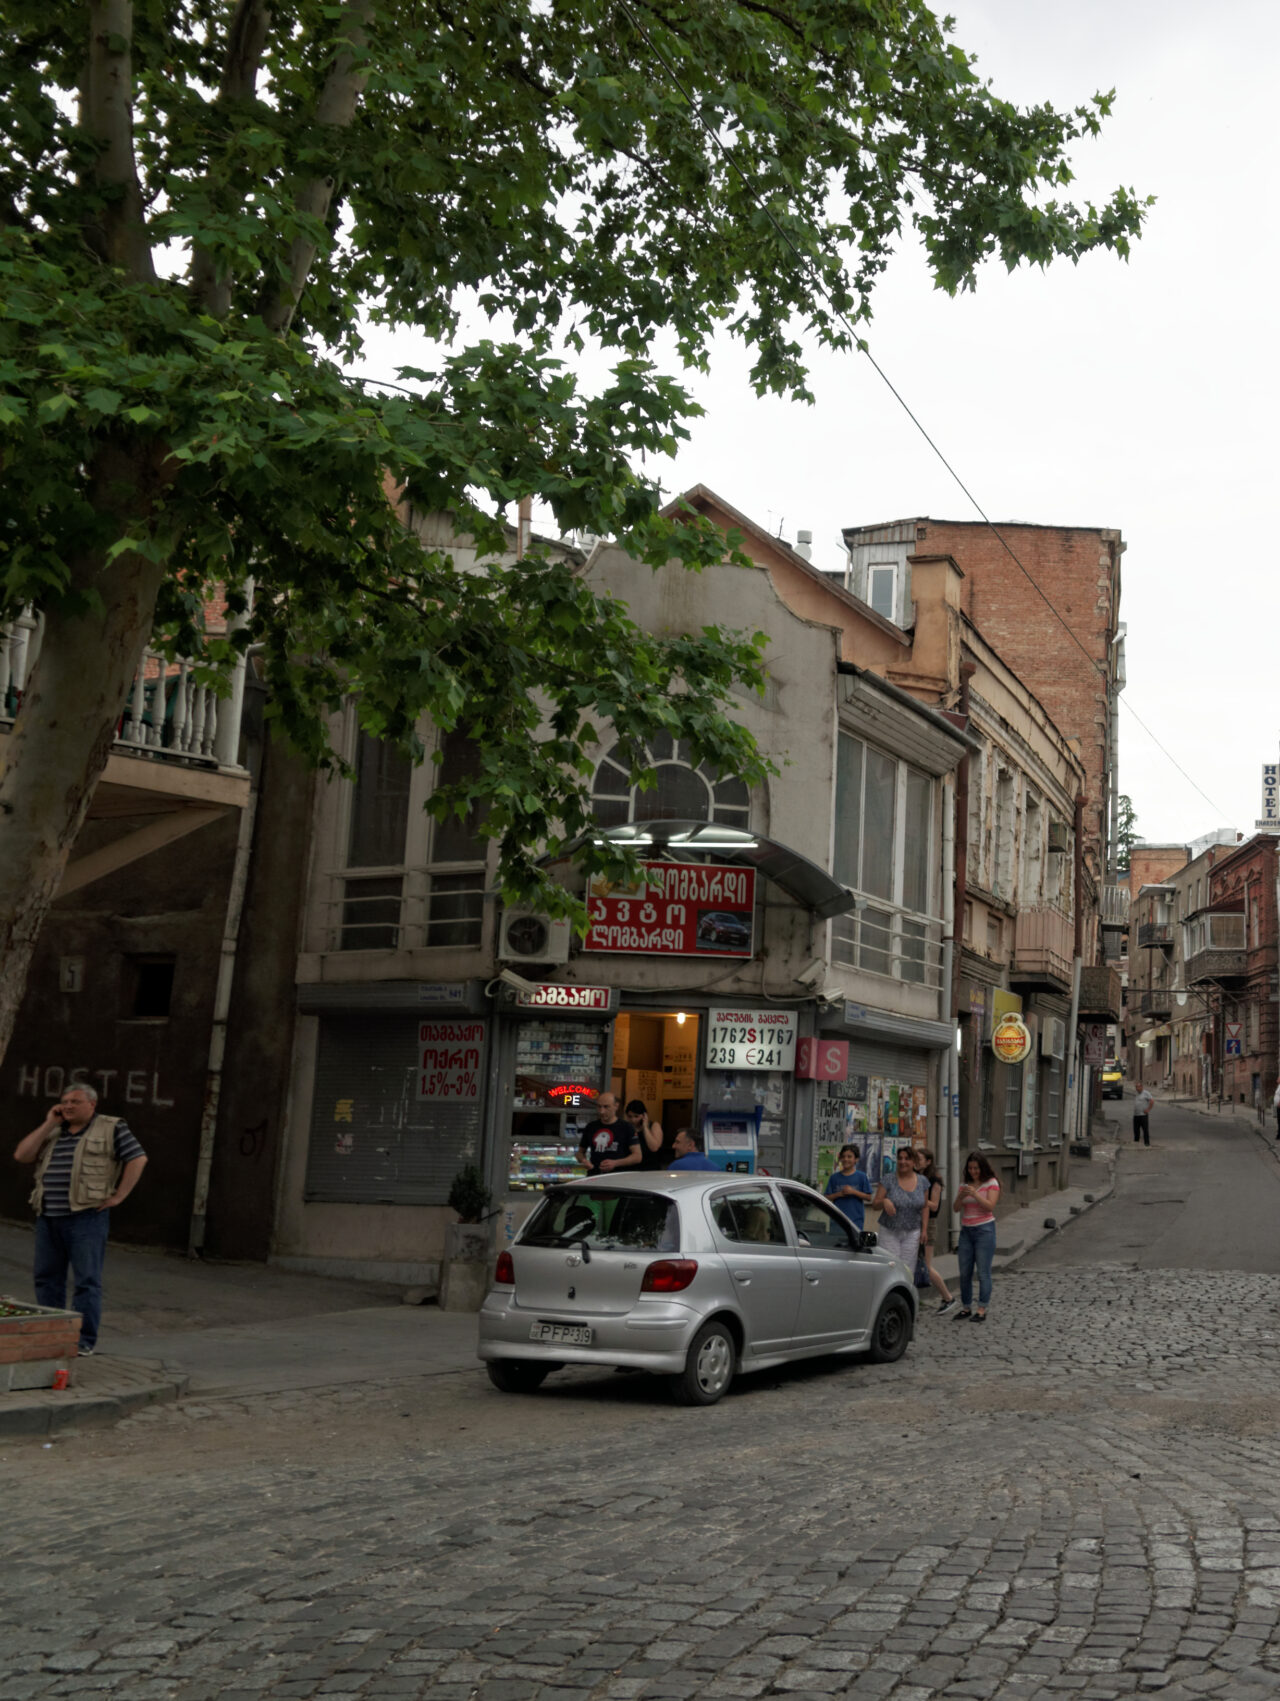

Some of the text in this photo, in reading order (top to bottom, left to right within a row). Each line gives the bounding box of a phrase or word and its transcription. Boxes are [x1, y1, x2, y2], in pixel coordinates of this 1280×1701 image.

[1264, 765, 1276, 818] HOTEL
[648, 867, 747, 905] ლომბარდი
[592, 925, 684, 951] ლომბარდი
[420, 1025, 484, 1042] თამბაქო
[423, 1049, 479, 1070] ოქრო
[709, 1047, 736, 1064] 239
[756, 1049, 782, 1066] 241
